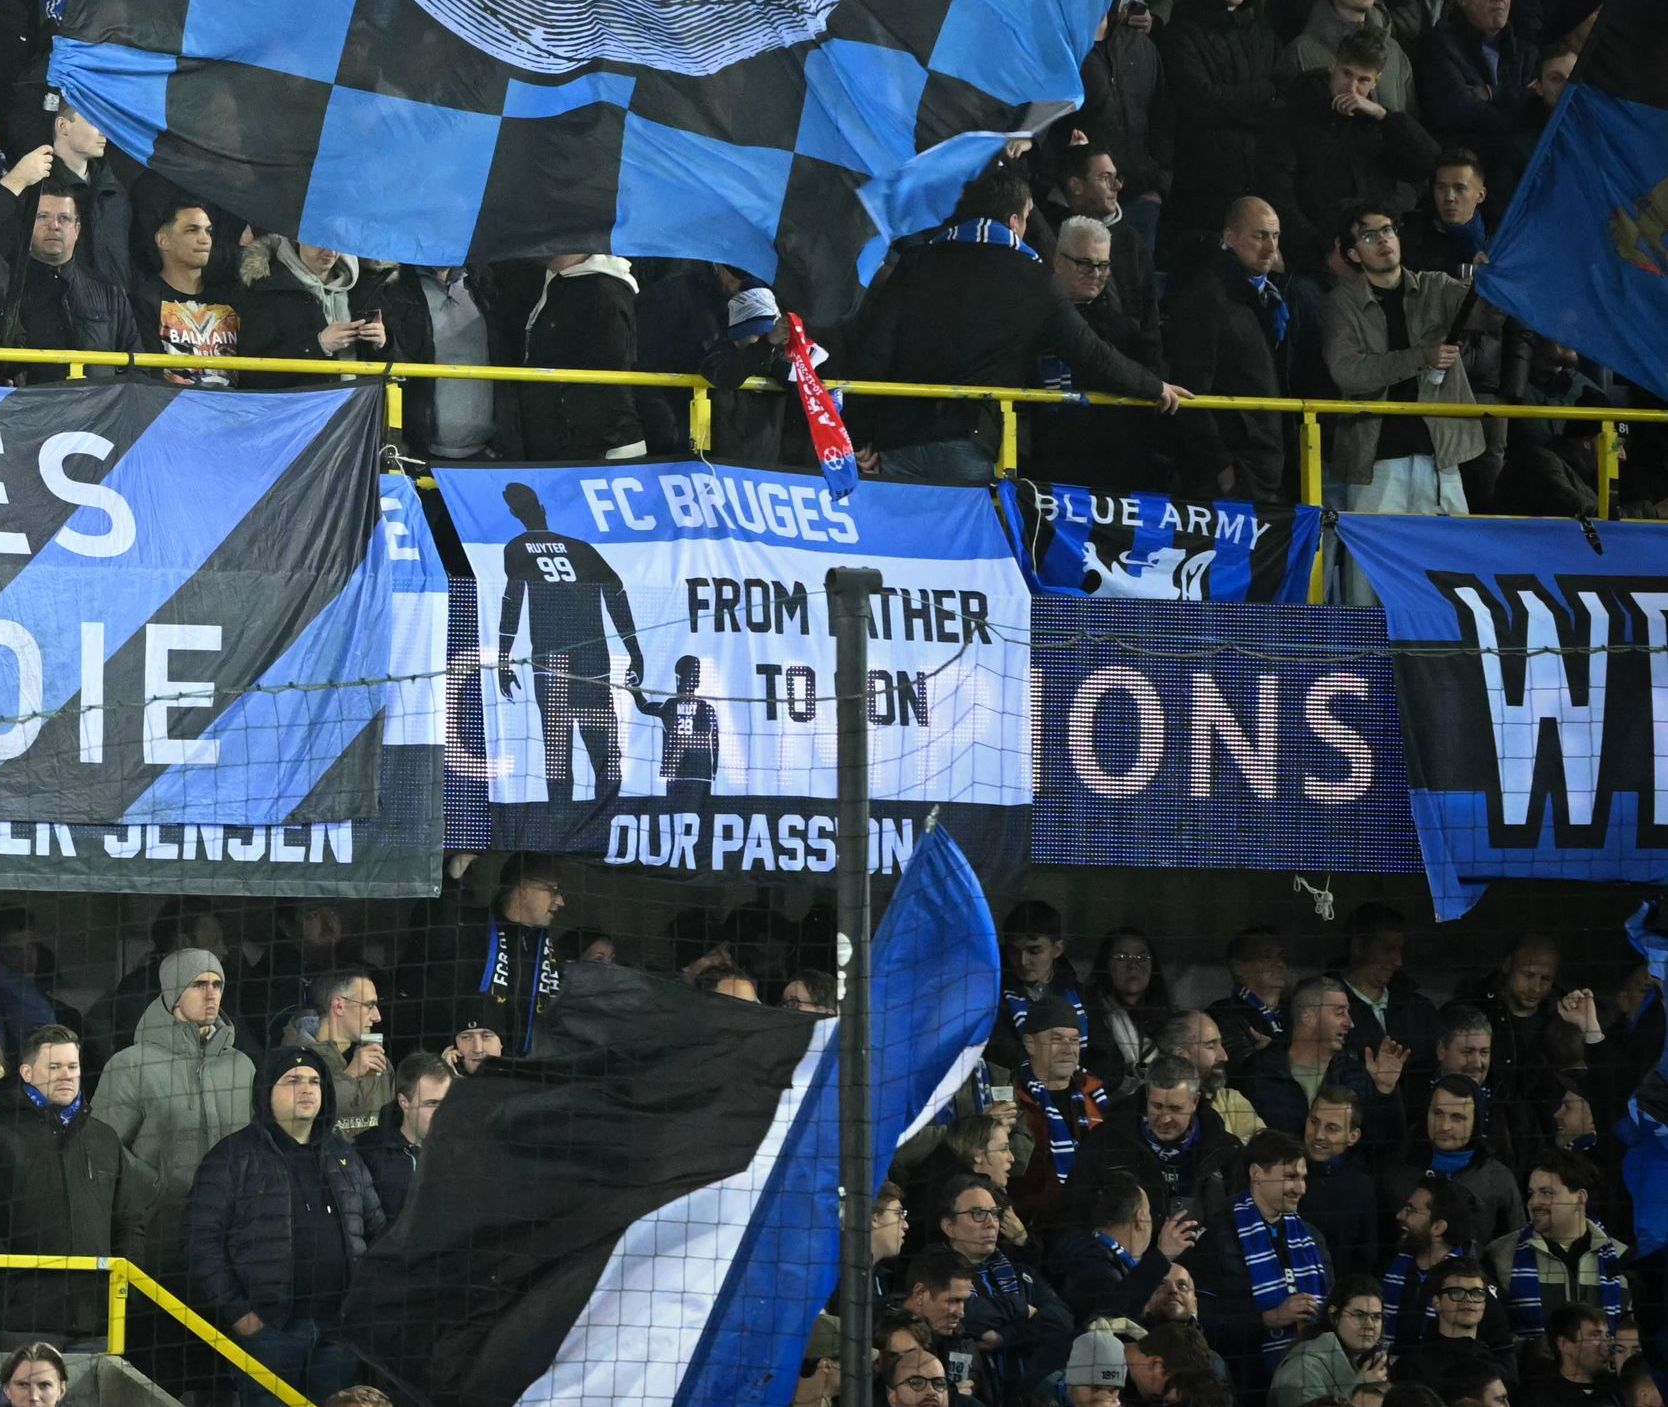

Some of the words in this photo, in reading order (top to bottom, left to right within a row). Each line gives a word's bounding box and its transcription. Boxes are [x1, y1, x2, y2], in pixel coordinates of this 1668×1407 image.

[170, 329, 238, 345] BALMAIN
[580, 477, 656, 532] FC
[659, 472, 859, 543] BRUGES
[1036, 494, 1144, 527] BLUE
[1162, 503, 1271, 551] ARMY
[526, 542, 567, 555] RUYTER
[536, 556, 577, 582] 99
[685, 578, 810, 635] FROM
[756, 663, 816, 723] TO
[604, 813, 696, 869] OUR
[1101, 1371, 1120, 1381] 1891
